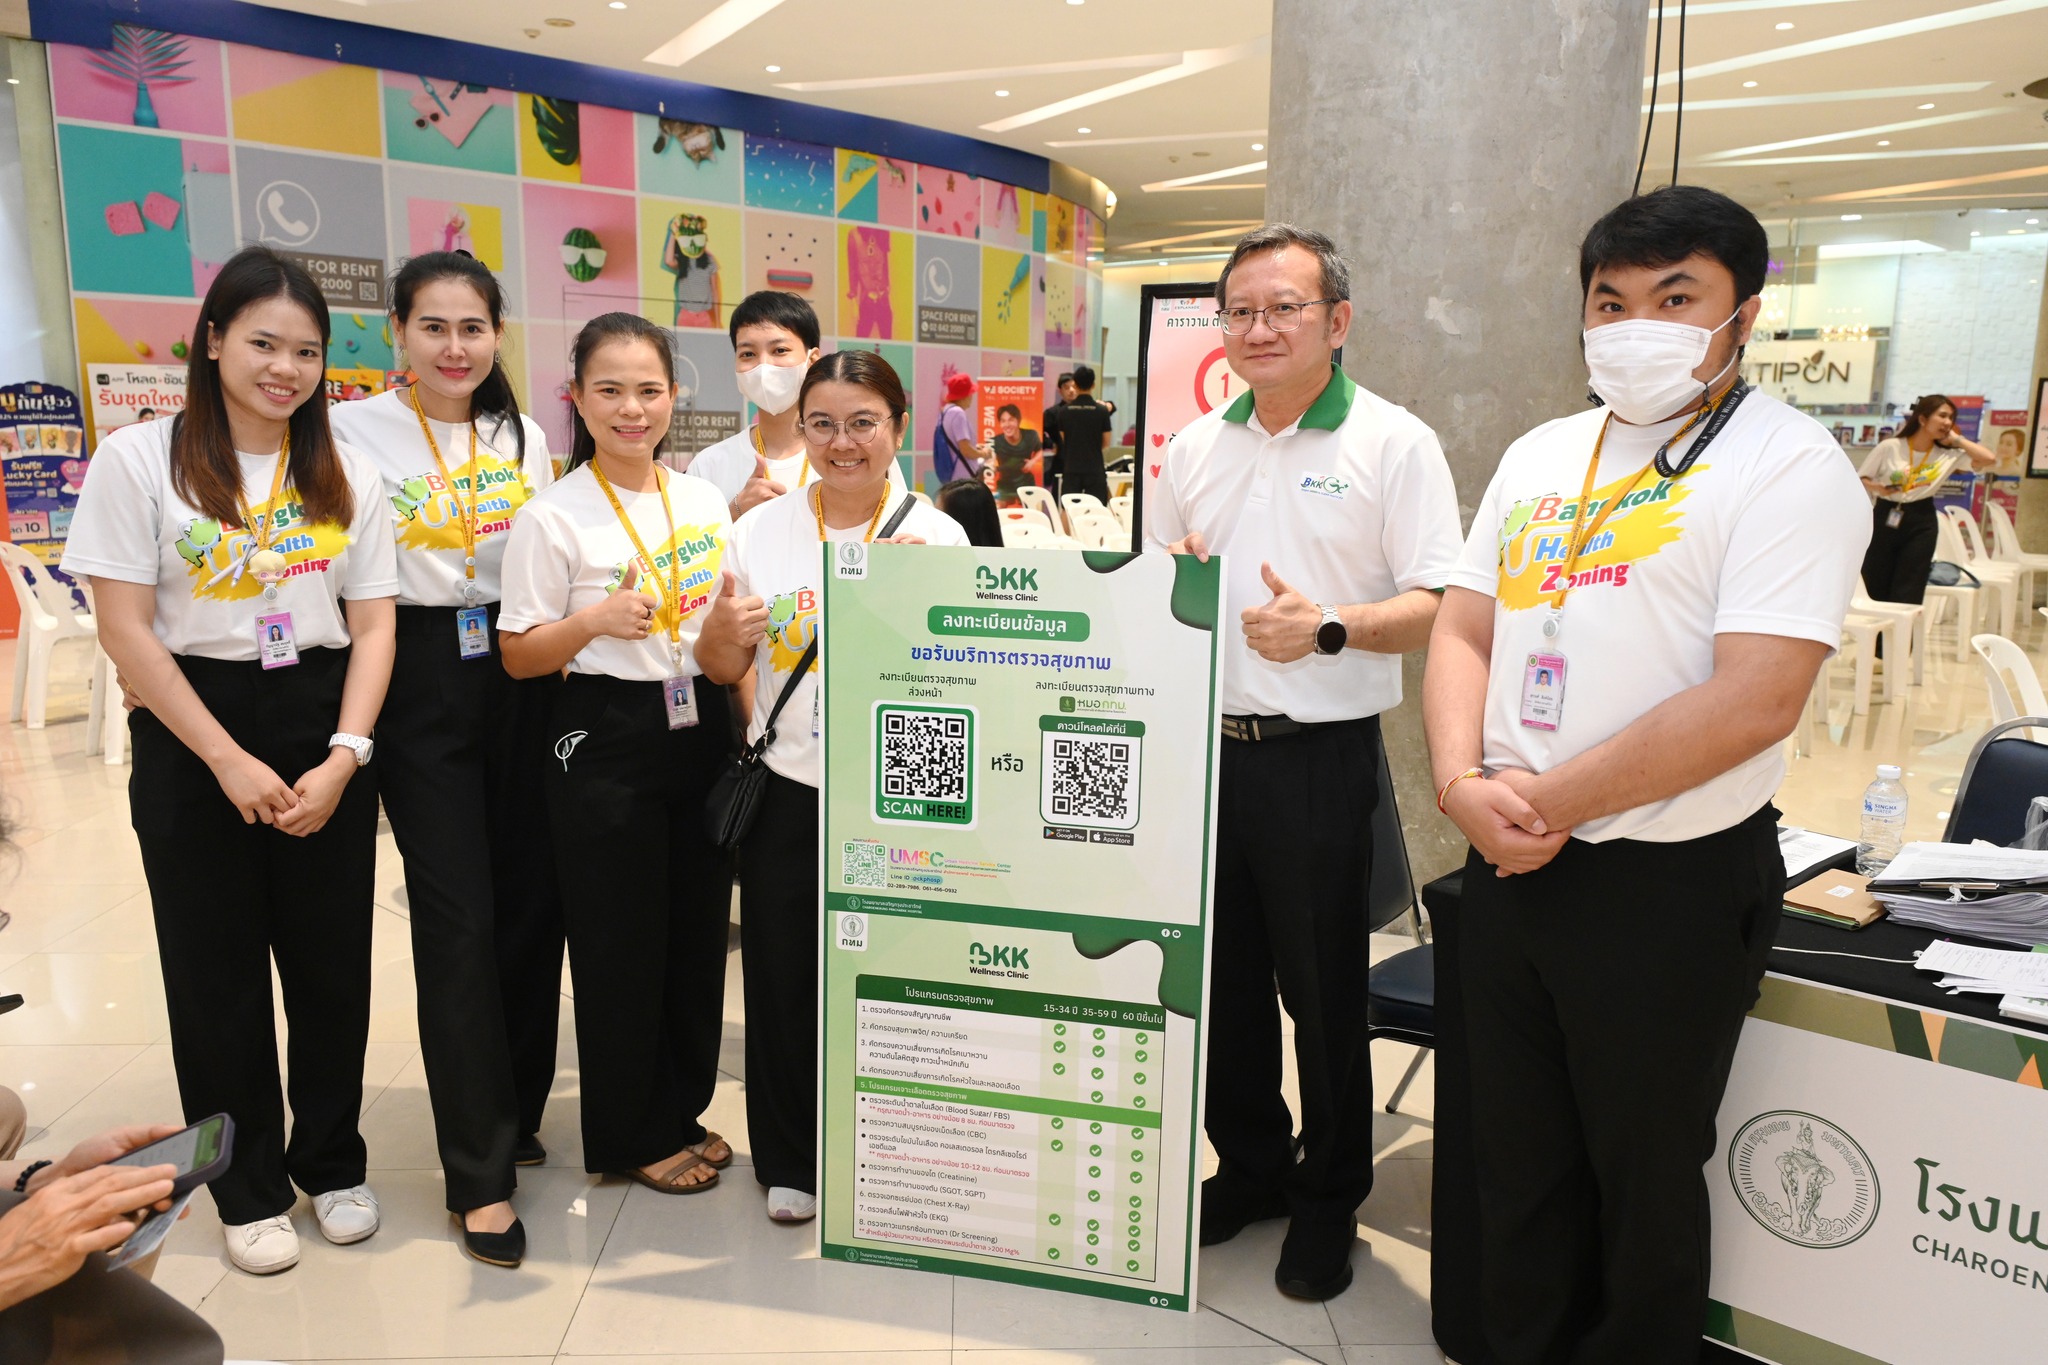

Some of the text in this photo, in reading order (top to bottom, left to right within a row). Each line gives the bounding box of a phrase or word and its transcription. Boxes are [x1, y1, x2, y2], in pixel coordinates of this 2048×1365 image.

[307, 259, 337, 275] FOR
[341, 263, 378, 278] RENT
[321, 278, 352, 291] 2000
[944, 312, 959, 322] FOR
[1166, 317, 1209, 328] คาราวาน
[126, 372, 157, 385] โหลด
[998, 386, 1037, 395] SOCIETY
[1220, 373, 1229, 399] 1
[711, 416, 736, 428] RENT
[696, 429, 719, 439] 2000
[4, 470, 57, 480] ucky Card
[25, 522, 41, 533] 10
[282, 558, 331, 579] oning
[840, 566, 863, 577] กทม
[976, 565, 1039, 592] BKK
[976, 592, 1039, 603] Wellness Clinic
[942, 613, 1068, 638] ลงทะเบียนข้อมูล
[911, 644, 1112, 674] ขอรับบริการตรวจสุขภาพ
[879, 672, 977, 688] ลงทะเบียนตรวจสุขภาพ
[908, 685, 943, 699] ล่วงหน้า
[1035, 680, 1155, 698] ลงทะเบียนตรวจสุขภาพทาง
[1057, 720, 1127, 735] ดาวน์โหลดได้ที่นี่
[991, 753, 1024, 772] หรือ
[883, 801, 966, 819] SCAN HERE!
[1874, 803, 1897, 811] SINGHA
[1056, 832, 1086, 841] Google Play
[1103, 836, 1115, 844] App
[890, 848, 944, 868] UMSC
[842, 937, 863, 948] กทม
[969, 941, 1030, 970] BKK
[969, 966, 1030, 980] Wellness Clinic
[905, 986, 995, 1006] โปรแกรมตรวจสุขภาพ
[1043, 1003, 1070, 1014] 15-34
[1082, 1008, 1109, 1018] 35-59
[1122, 1012, 1134, 1021] 60
[1136, 1010, 1163, 1024] ปีขึ้นไป
[862, 1005, 952, 1021] 1. ตรวจคัดกรองสัญญาณชีพ
[861, 1022, 868, 1030] 2.
[931, 1029, 968, 1041] ความเครียด
[860, 1039, 988, 1060] 3. คัดกรองความเสี่ยงการเกิดโรคเบาหวาน
[860, 1065, 1021, 1091] 4. คัดกรองความเสี่ยงการเกิดโรคหัวใจและหลอดเลือด
[860, 1081, 868, 1089] 5.
[869, 1096, 1011, 1121] ตรวจระดับน้ำตาลในเลือด (Blood Sugar/ FBS)
[966, 1130, 987, 1140] (CBC)
[961, 1162, 981, 1171] 10-12
[937, 1170, 978, 1184] (Creatinine)
[939, 1186, 963, 1197] (SGOT,
[964, 1188, 986, 1200] SGPT)
[859, 1190, 866, 1198] 6.
[924, 1197, 946, 1208] (Chest
[947, 1200, 971, 1211] X-Ray)
[859, 1204, 866, 1212] 7.
[929, 1213, 949, 1223] (EKG)
[859, 1218, 866, 1226] 8.
[949, 1228, 960, 1238] (Dr
[961, 1231, 998, 1244] Screening)
